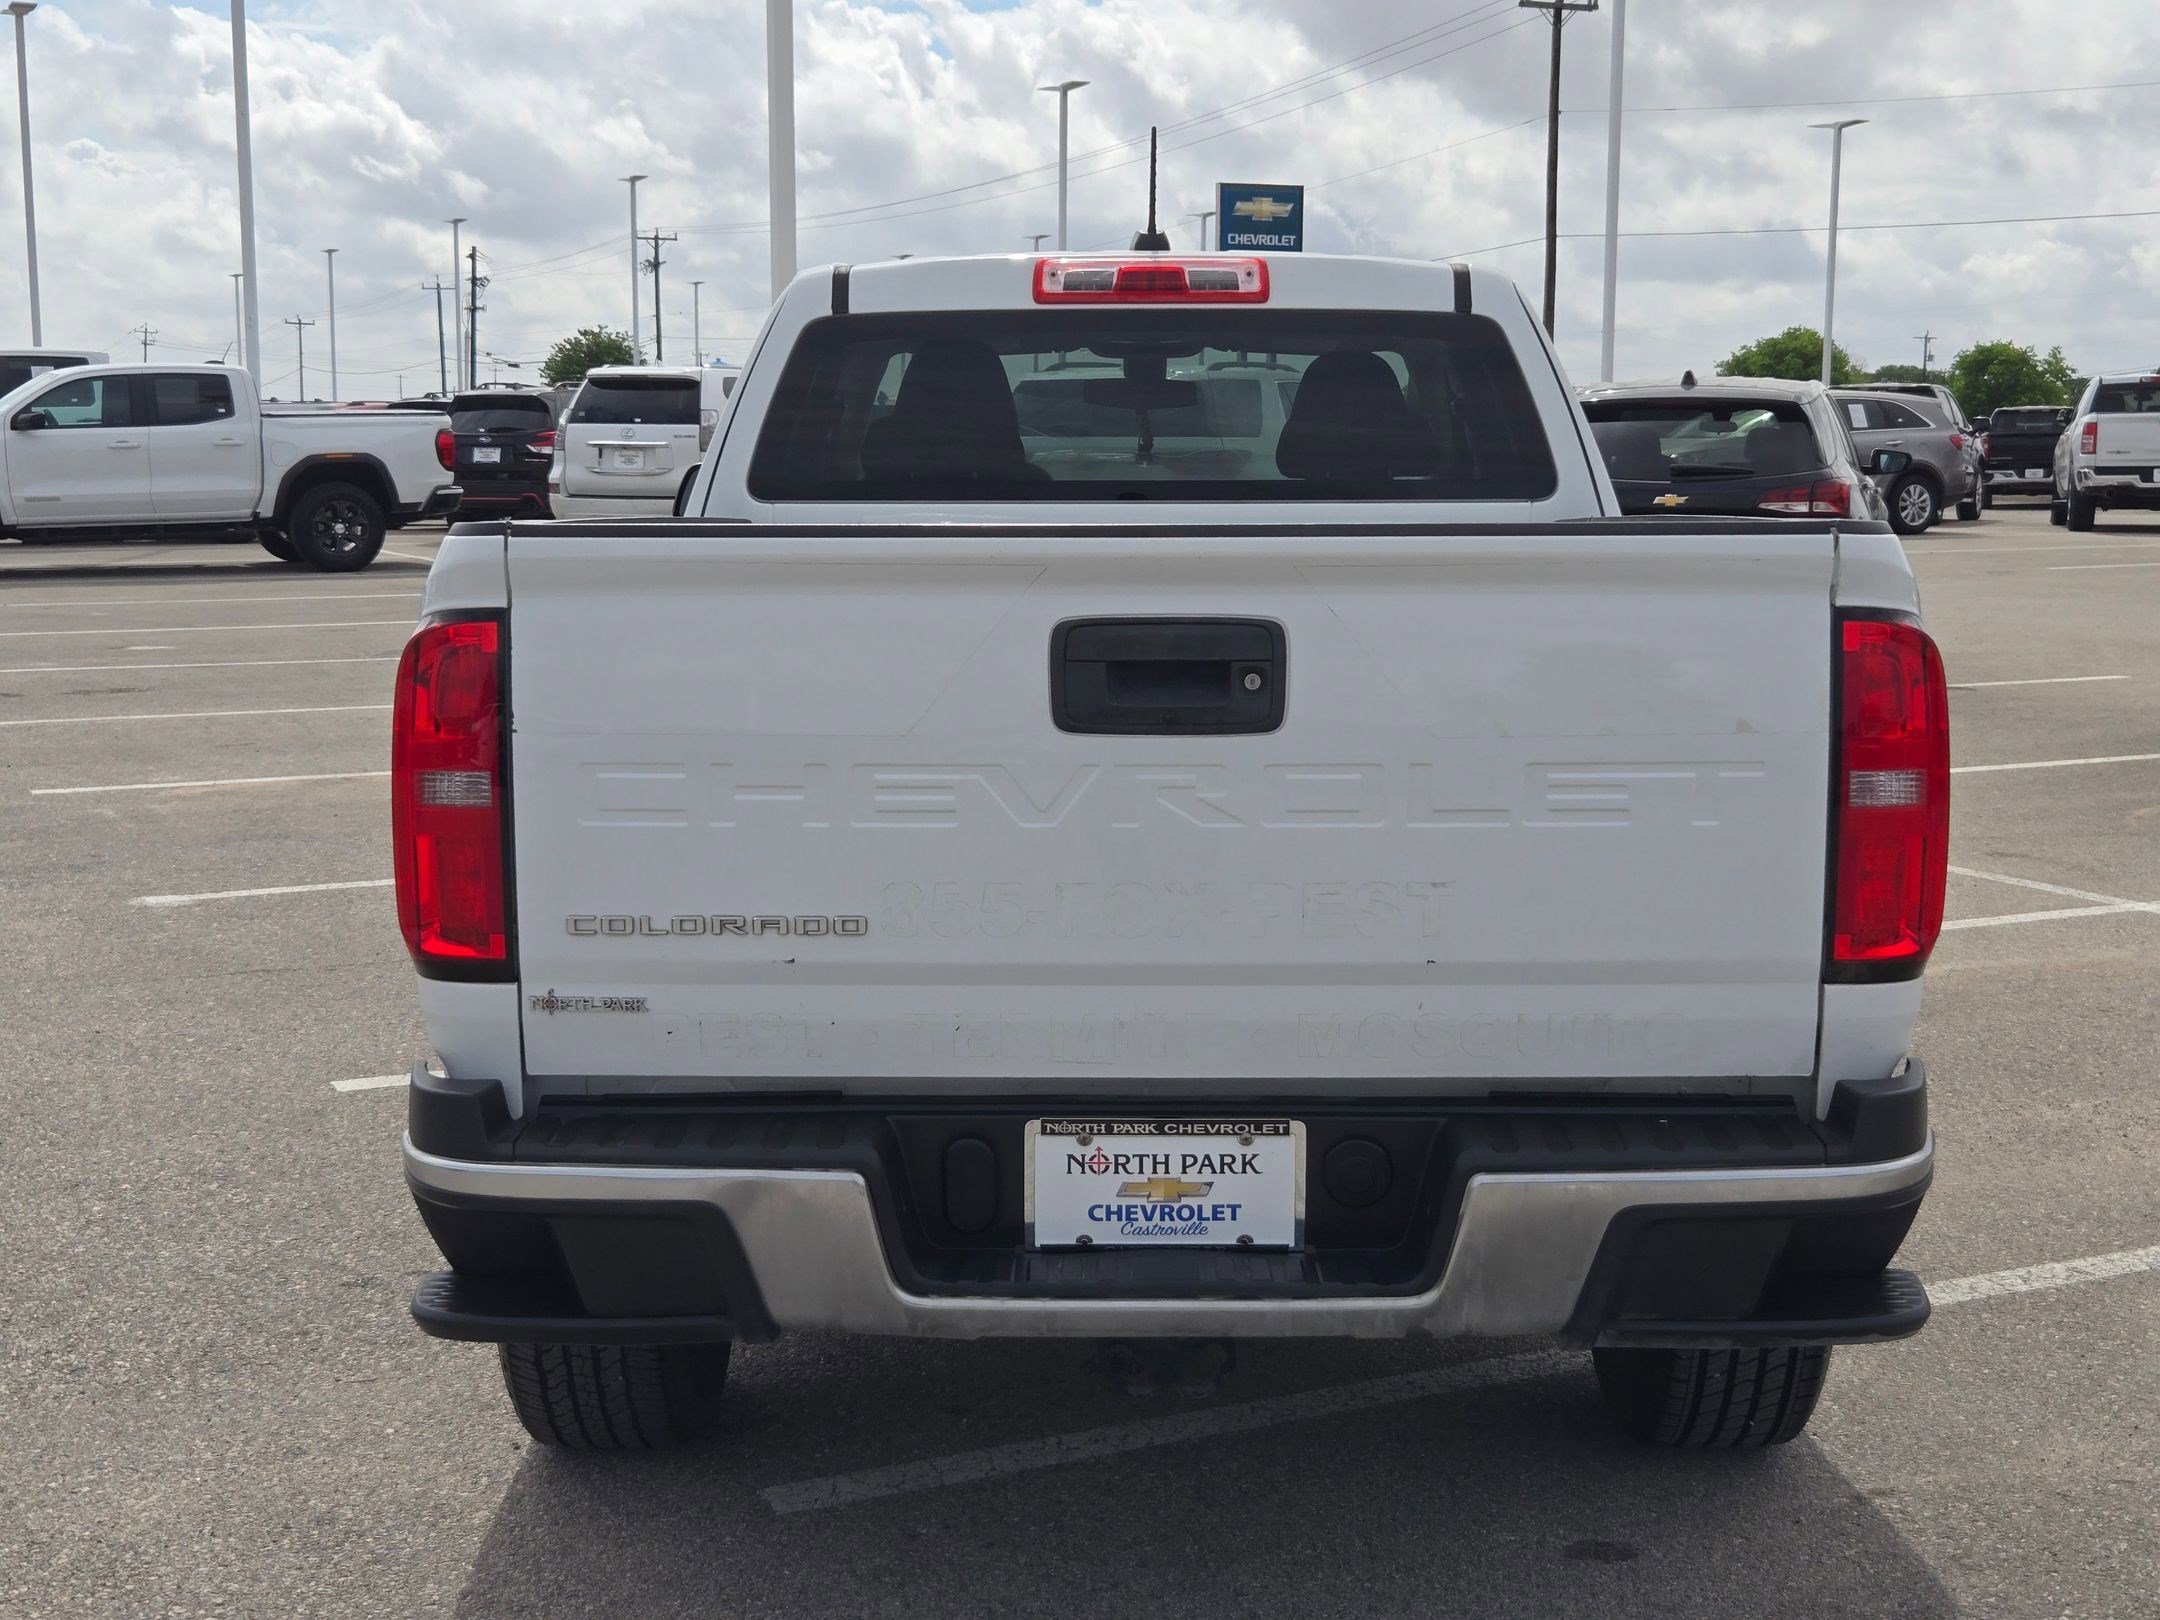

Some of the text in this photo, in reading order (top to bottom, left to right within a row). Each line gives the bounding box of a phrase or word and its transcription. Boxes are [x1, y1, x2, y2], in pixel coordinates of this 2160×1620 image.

[1227, 233, 1297, 246] CHEVROLET
[577, 761, 1767, 829] CHEVROLET
[565, 914, 869, 936] COLORADO
[528, 989, 649, 1015] NORTH PARK
[1044, 1121, 1288, 1135] NORTH PARK CHEVROLET
[1066, 1146, 1264, 1176] NORTH PARK
[1087, 1203, 1242, 1222] CHEVROLET
[1120, 1221, 1209, 1237] Castroville
